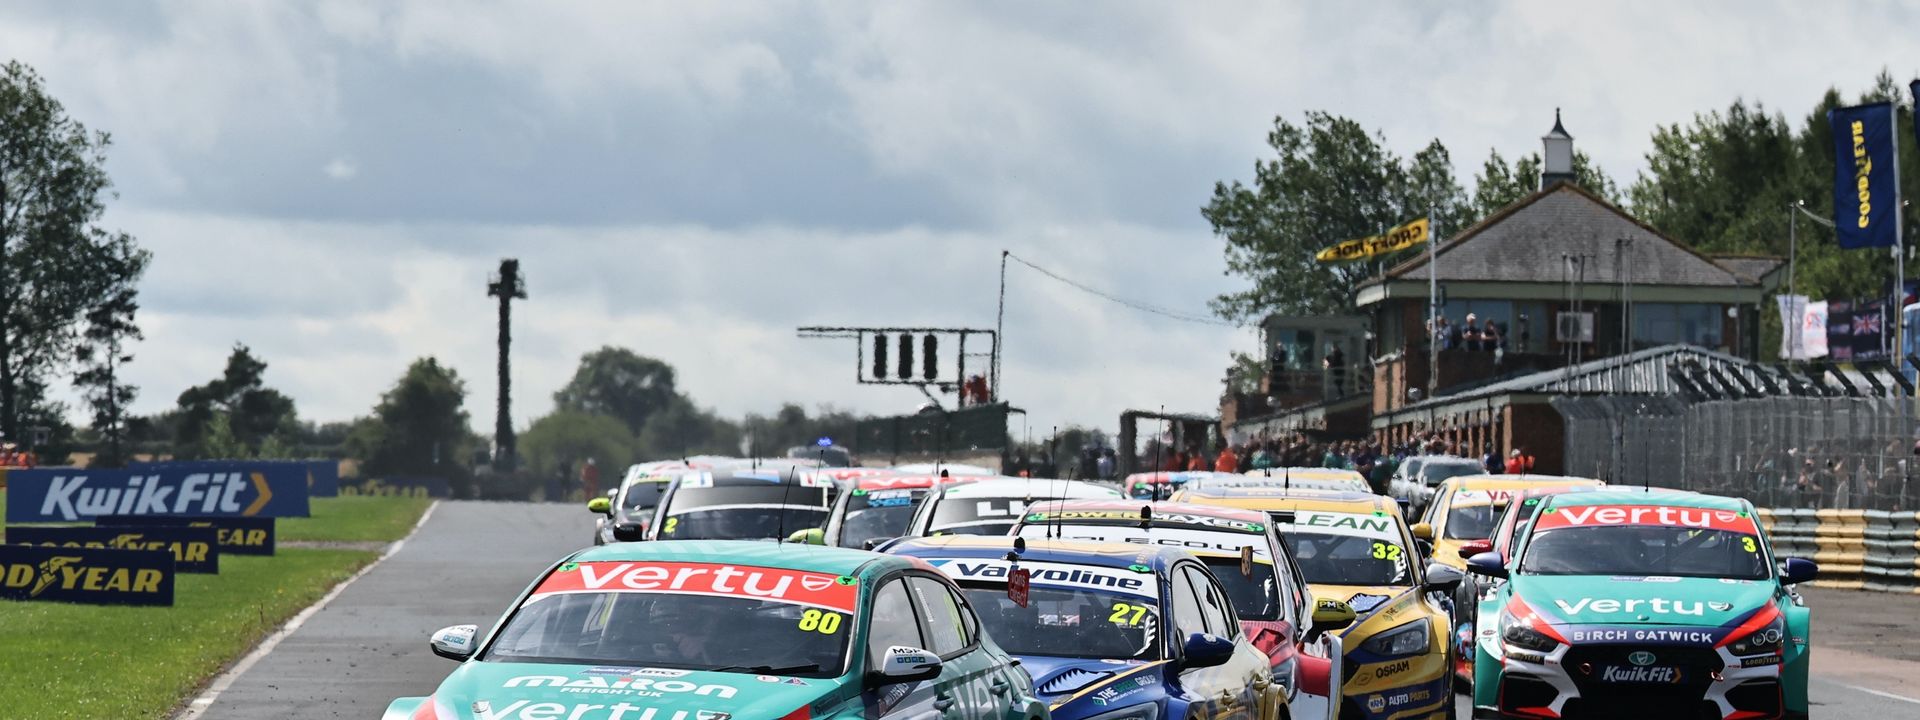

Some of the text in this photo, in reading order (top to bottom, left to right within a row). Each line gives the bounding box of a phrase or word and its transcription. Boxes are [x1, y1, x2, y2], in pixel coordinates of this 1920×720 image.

[664, 517, 678, 533] 2
[1300, 514, 1389, 532] EAN
[1559, 506, 1710, 527] Vertu
[1372, 542, 1401, 561] 32
[1741, 536, 1757, 553] 3
[0, 563, 162, 593] DYEAR
[579, 563, 793, 597] Vertu
[798, 609, 841, 635] 80
[1108, 603, 1147, 626] 27
[1573, 630, 1713, 643] BIRCH GATWICK
[1375, 660, 1410, 679] OSRAM
[1745, 656, 1779, 666] GOODYEAR
[560, 687, 665, 698] FREIGHT UK
